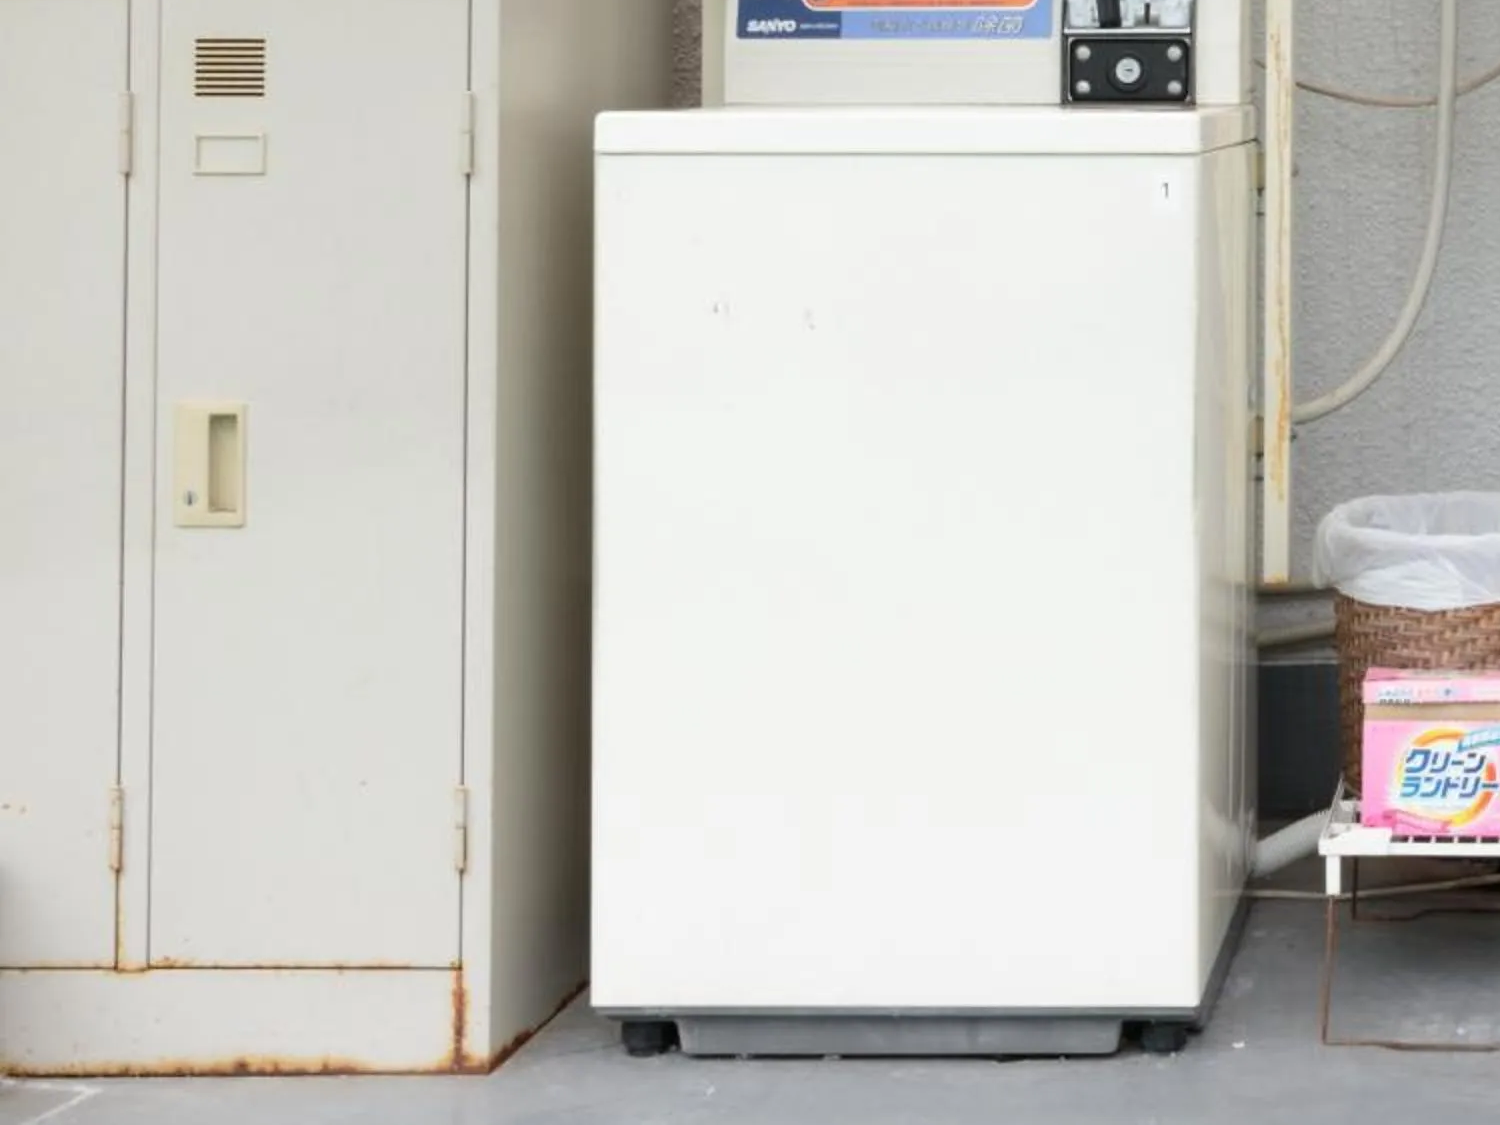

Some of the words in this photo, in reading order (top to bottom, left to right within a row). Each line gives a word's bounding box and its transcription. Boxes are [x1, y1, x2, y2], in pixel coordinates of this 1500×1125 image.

[746, 17, 797, 33] SANYO
[1161, 182, 1169, 200] 1
[1405, 749, 1487, 774] クリーン
[1400, 775, 1500, 798] ランドリー
